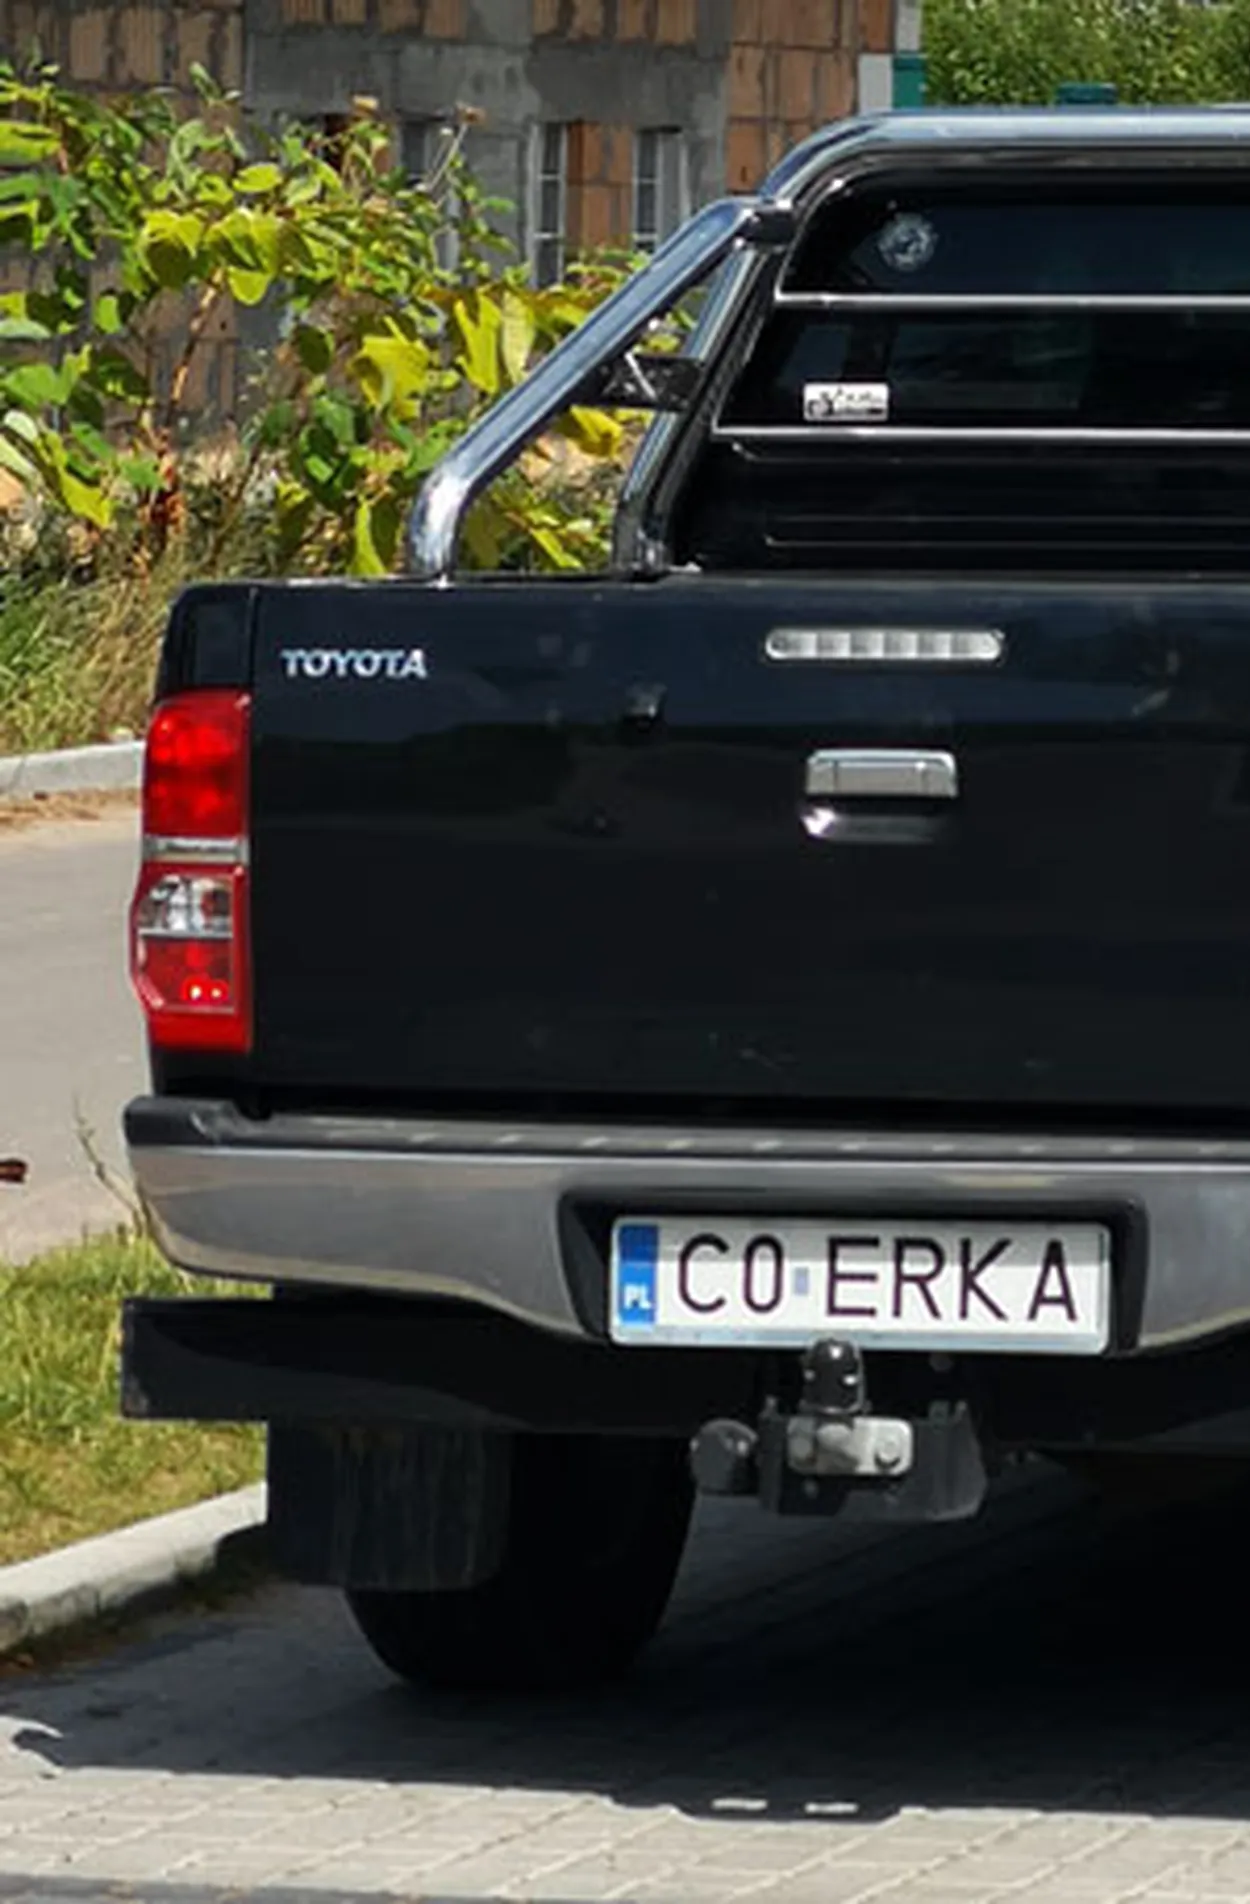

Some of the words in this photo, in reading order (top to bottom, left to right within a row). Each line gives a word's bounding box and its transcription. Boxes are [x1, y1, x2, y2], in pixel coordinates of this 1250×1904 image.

[280, 648, 428, 679] TOYOTA
[825, 1236, 1079, 1322] ERKA
[623, 1283, 652, 1309] PL
